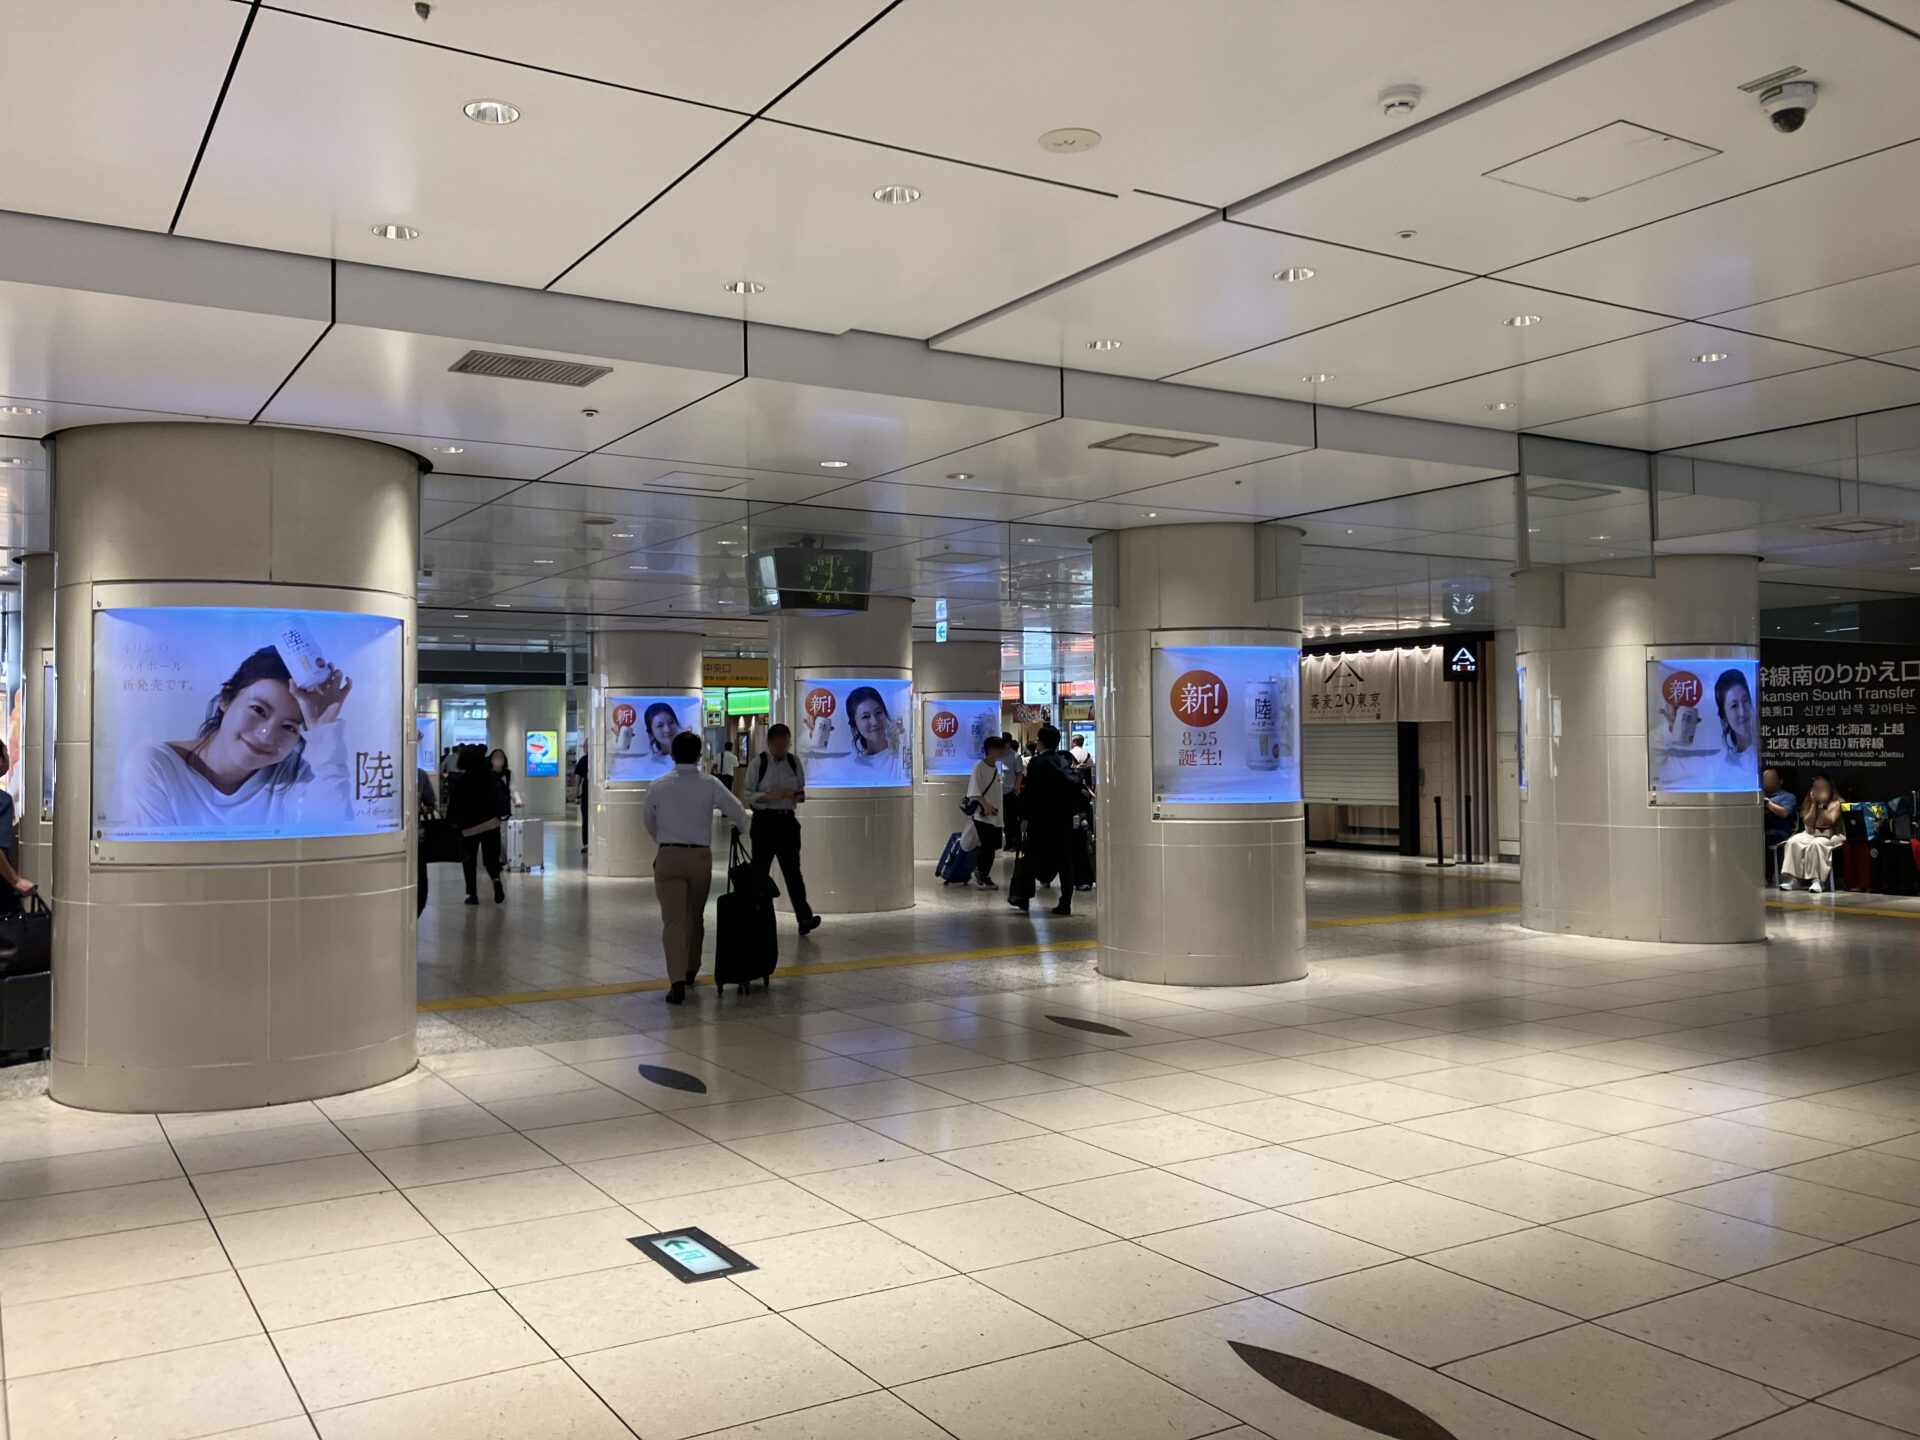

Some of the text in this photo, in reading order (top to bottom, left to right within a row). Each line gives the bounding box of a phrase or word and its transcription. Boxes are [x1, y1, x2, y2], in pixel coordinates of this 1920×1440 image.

[122, 660, 183, 672] ハイボール
[123, 678, 194, 692] 新発売です。
[1762, 686, 1916, 702] kansen South Transfer
[1254, 698, 1272, 720] 陸
[1182, 731, 1218, 747] 8.25
[1843, 759, 1887, 768] Shinkansen
[355, 750, 394, 801] 陸
